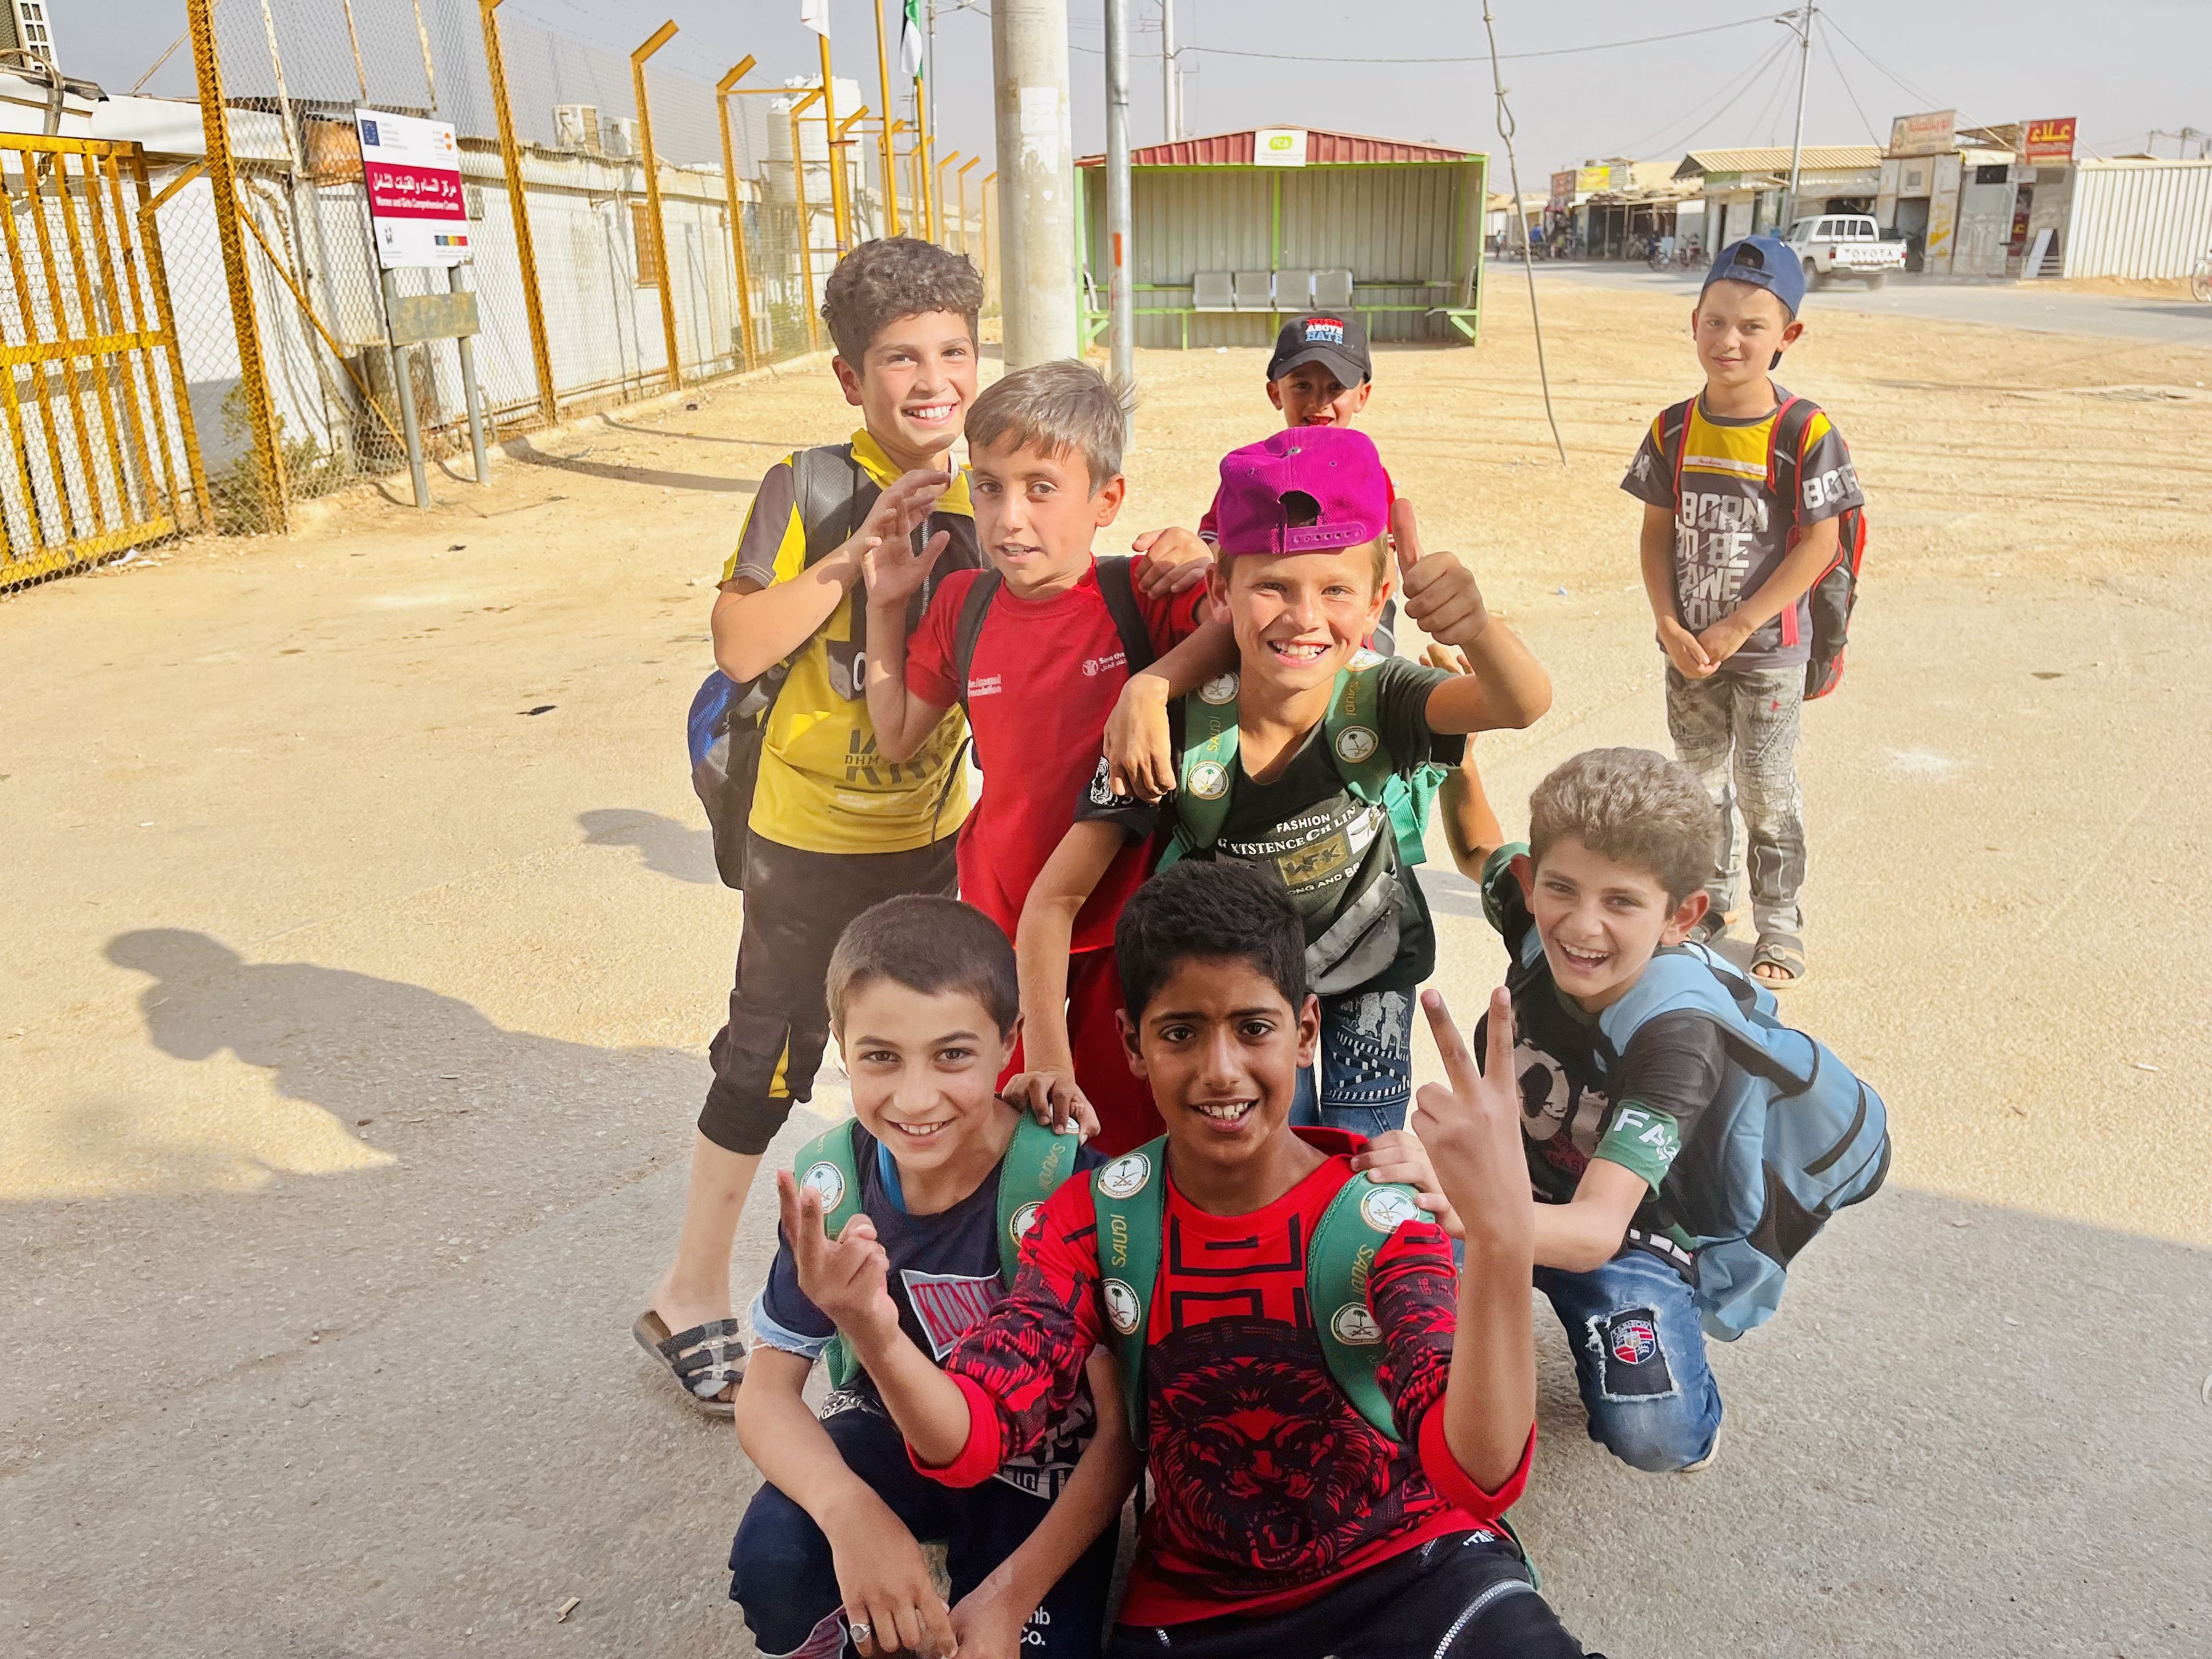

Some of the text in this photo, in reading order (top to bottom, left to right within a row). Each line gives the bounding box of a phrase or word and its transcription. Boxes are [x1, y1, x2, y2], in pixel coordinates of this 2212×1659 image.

[1844, 249, 1893, 258] TOYOTA
[1306, 324, 1344, 335] ABOVE
[1306, 331, 1344, 345] HATE
[1681, 491, 1769, 533] BORN
[1707, 532, 1753, 568] BE
[1345, 680, 1359, 716] SAUDI
[1207, 715, 1221, 753] SAUDI
[1276, 812, 1331, 833] FASHION
[1318, 873, 1343, 888] AND
[1110, 1214, 1128, 1268] SAUDI
